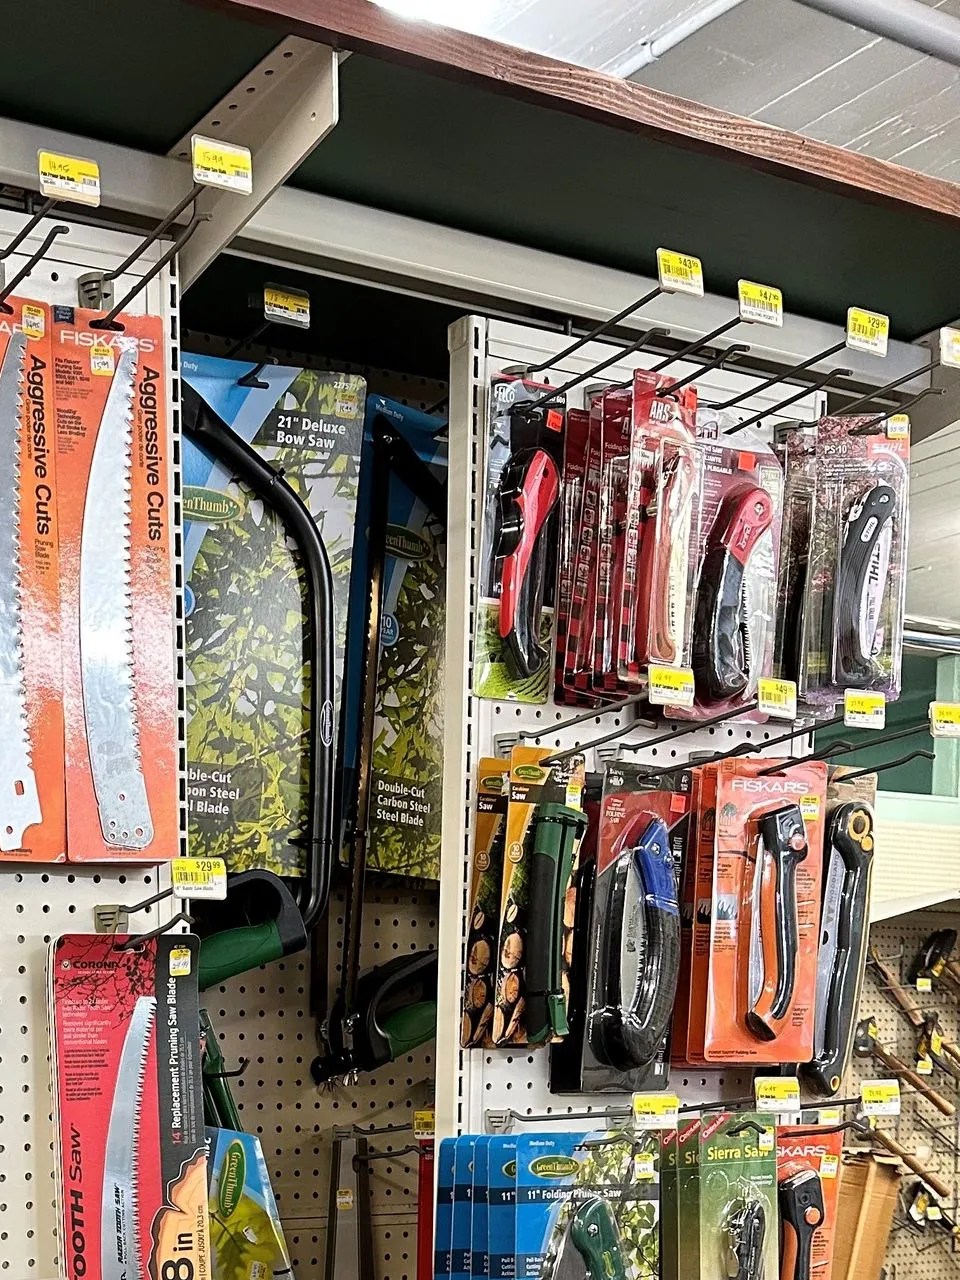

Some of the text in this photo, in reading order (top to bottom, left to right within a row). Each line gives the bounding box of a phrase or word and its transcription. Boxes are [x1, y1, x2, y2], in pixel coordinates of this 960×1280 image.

[277, 415, 346, 436] 21" Deluxe
[26, 354, 52, 536] Aggressive Cuts
[276, 430, 336, 449] Bow Saw
[138, 365, 164, 541] Aggressive Cuts
[209, 787, 240, 800] Steel
[378, 780, 425, 799] Double-Cut
[511, 791, 526, 801] Saw
[732, 780, 809, 794] FISKARS
[197, 802, 230, 815] Blade
[377, 795, 431, 814] Carbon Steel
[376, 809, 424, 827] Steel Blade
[73, 960, 120, 969] CORONA
[167, 977, 182, 1129] Replacement Pruning Saw Blade
[69, 1129, 83, 1183] Saw
[708, 1146, 740, 1160] Sierra
[224, 1151, 241, 1216] GreenThumb
[527, 1189, 622, 1200] 11" Folding Saw
[173, 1233, 193, 1251] in
